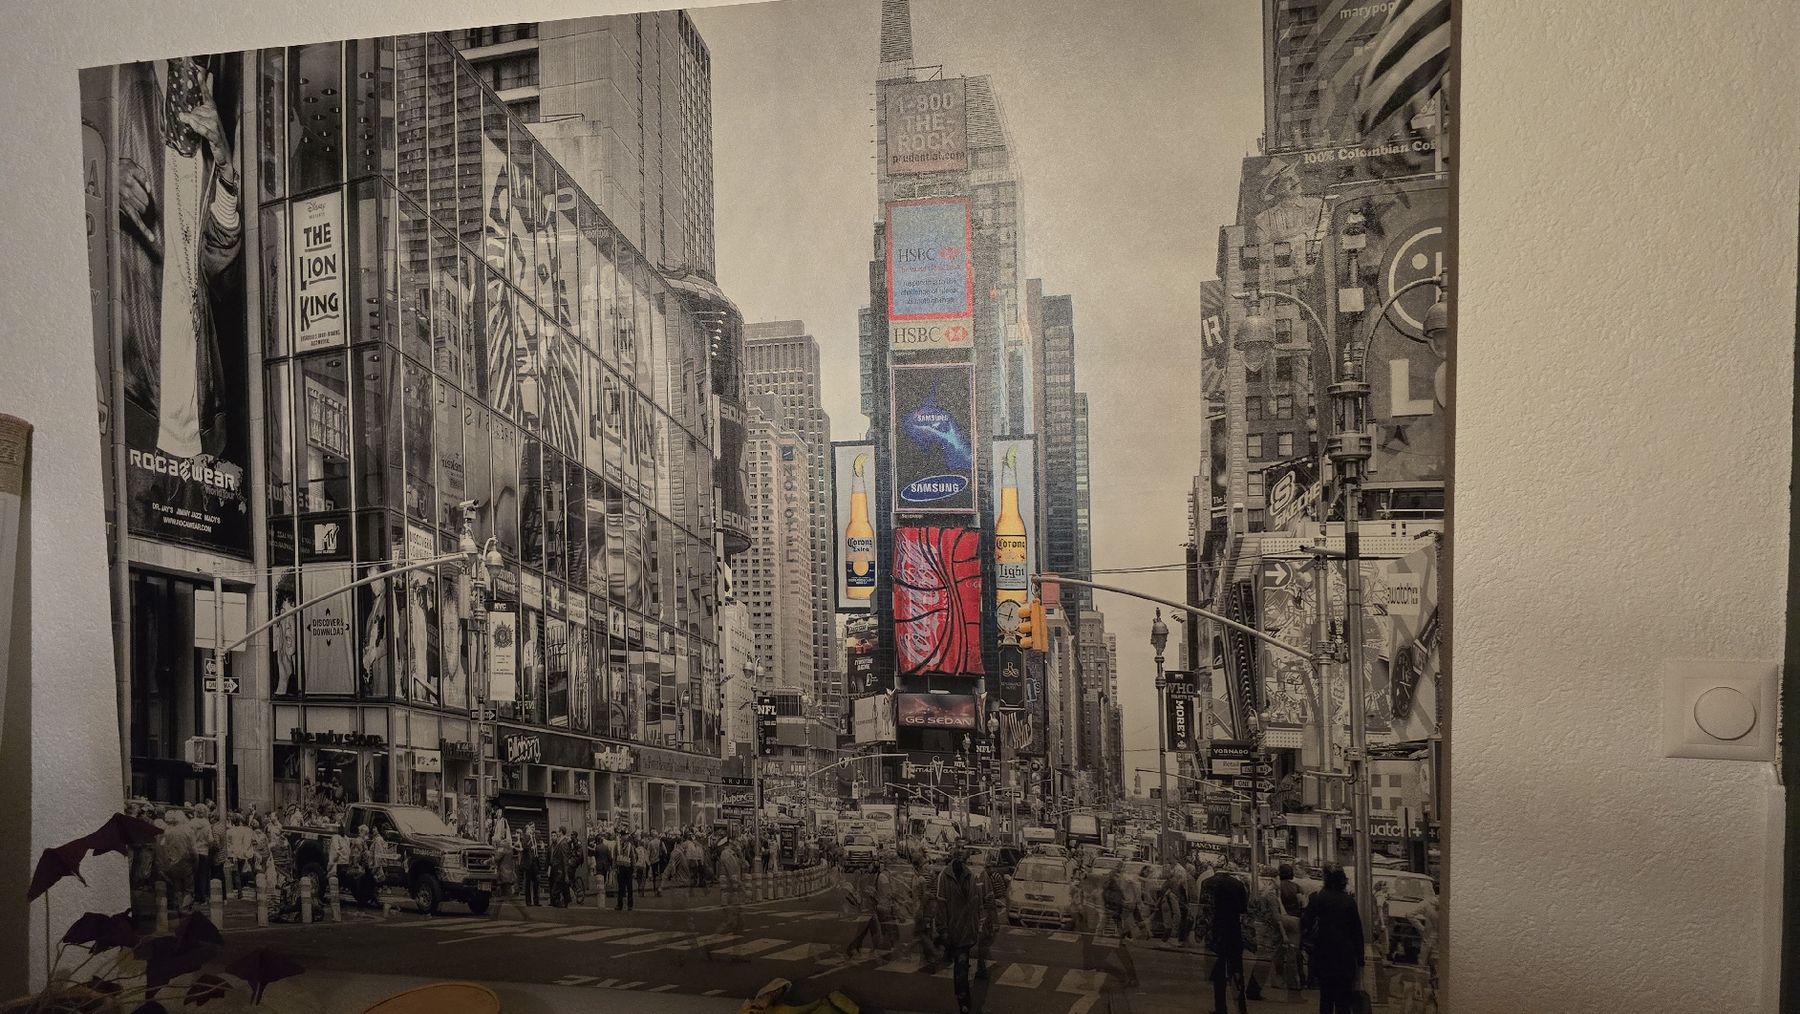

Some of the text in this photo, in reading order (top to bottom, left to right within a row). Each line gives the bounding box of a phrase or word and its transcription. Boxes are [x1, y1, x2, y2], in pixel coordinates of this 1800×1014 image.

[898, 132, 956, 151] ROCK
[1303, 150, 1335, 164] 100%
[1337, 143, 1410, 161] Colombian
[303, 222, 332, 247] THE
[898, 248, 936, 262] HSBC
[300, 252, 337, 291] LION
[300, 292, 339, 332] KING
[894, 326, 942, 344] HSBC
[911, 483, 959, 493] SAMSUNG
[757, 704, 777, 716] NFL
[905, 715, 972, 726] G6 SEDAN
[1175, 700, 1186, 739] MORE?
[976, 744, 992, 753] NFL
[1213, 748, 1249, 756] VORNADO
